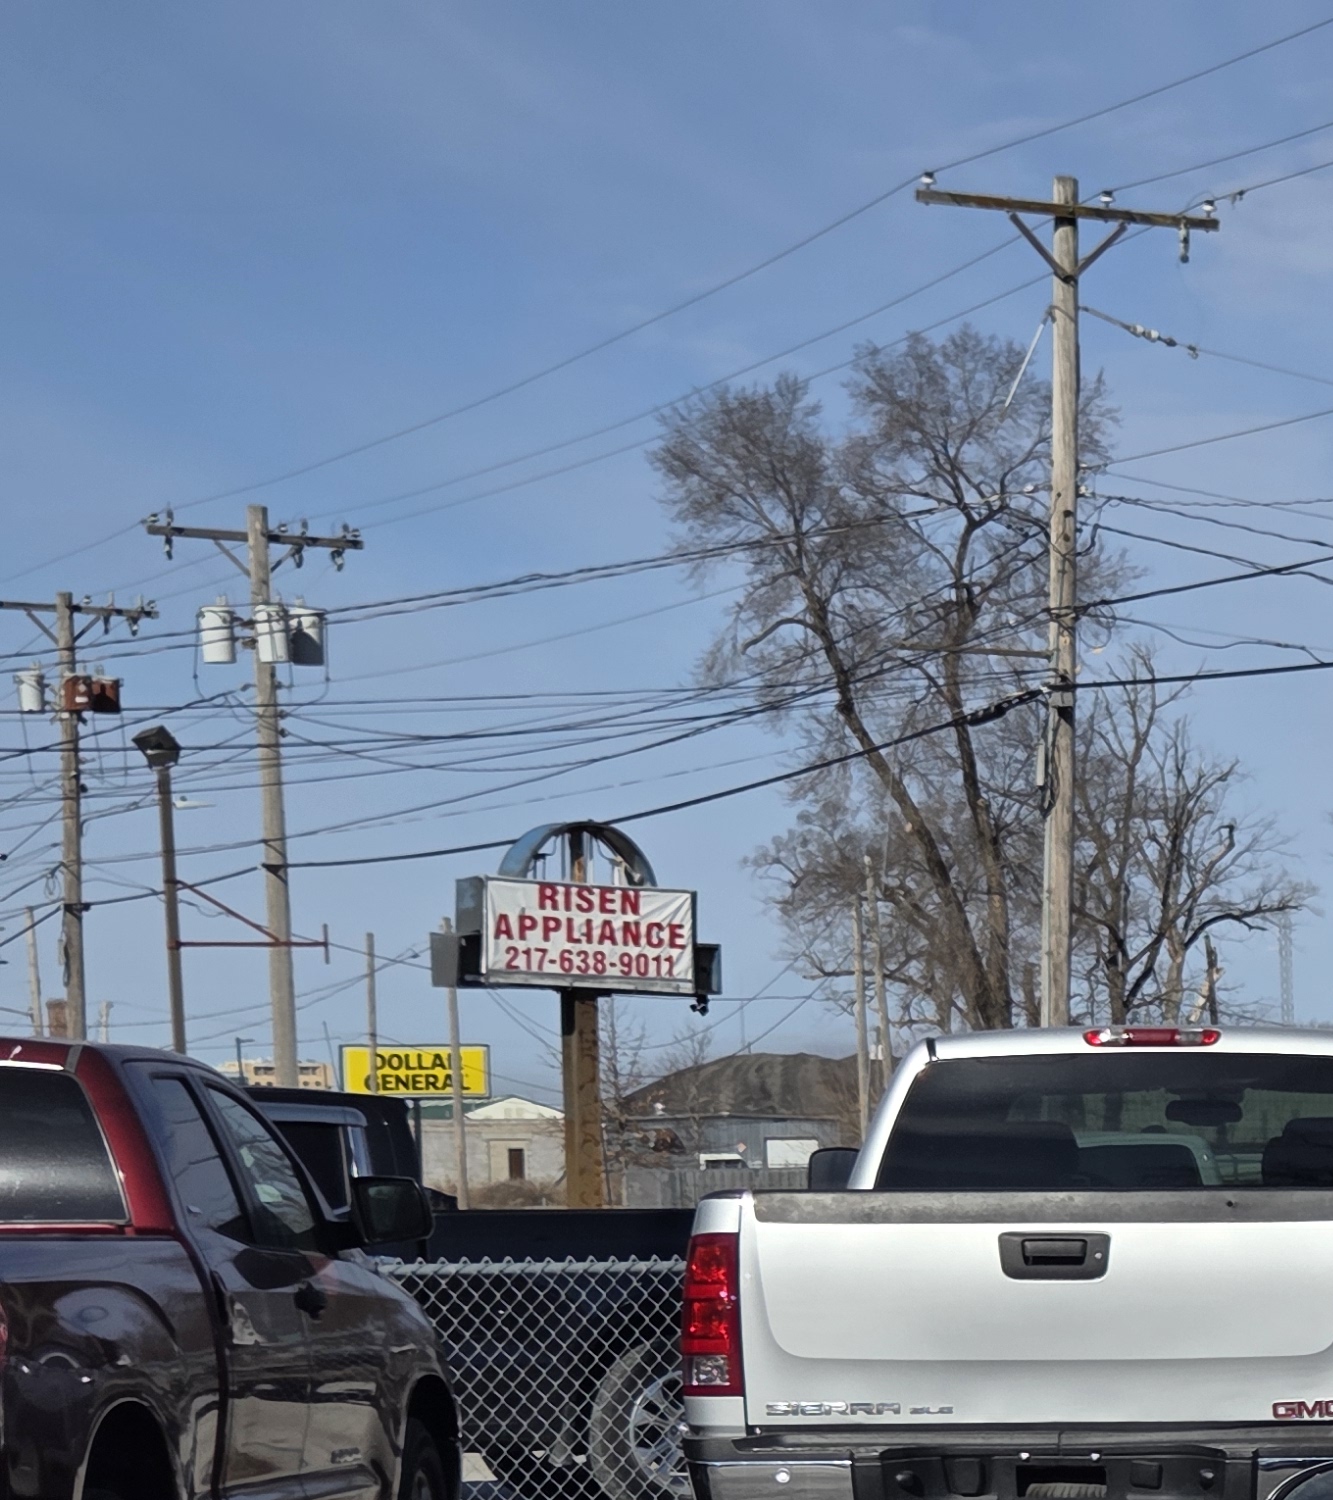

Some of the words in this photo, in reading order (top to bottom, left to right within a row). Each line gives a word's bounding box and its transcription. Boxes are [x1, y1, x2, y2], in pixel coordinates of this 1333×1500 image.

[538, 884, 641, 915] RISEN
[494, 914, 687, 949] APPLIANCE
[505, 946, 676, 978] 217-638-9011
[766, 1401, 901, 1417] SIERRA
